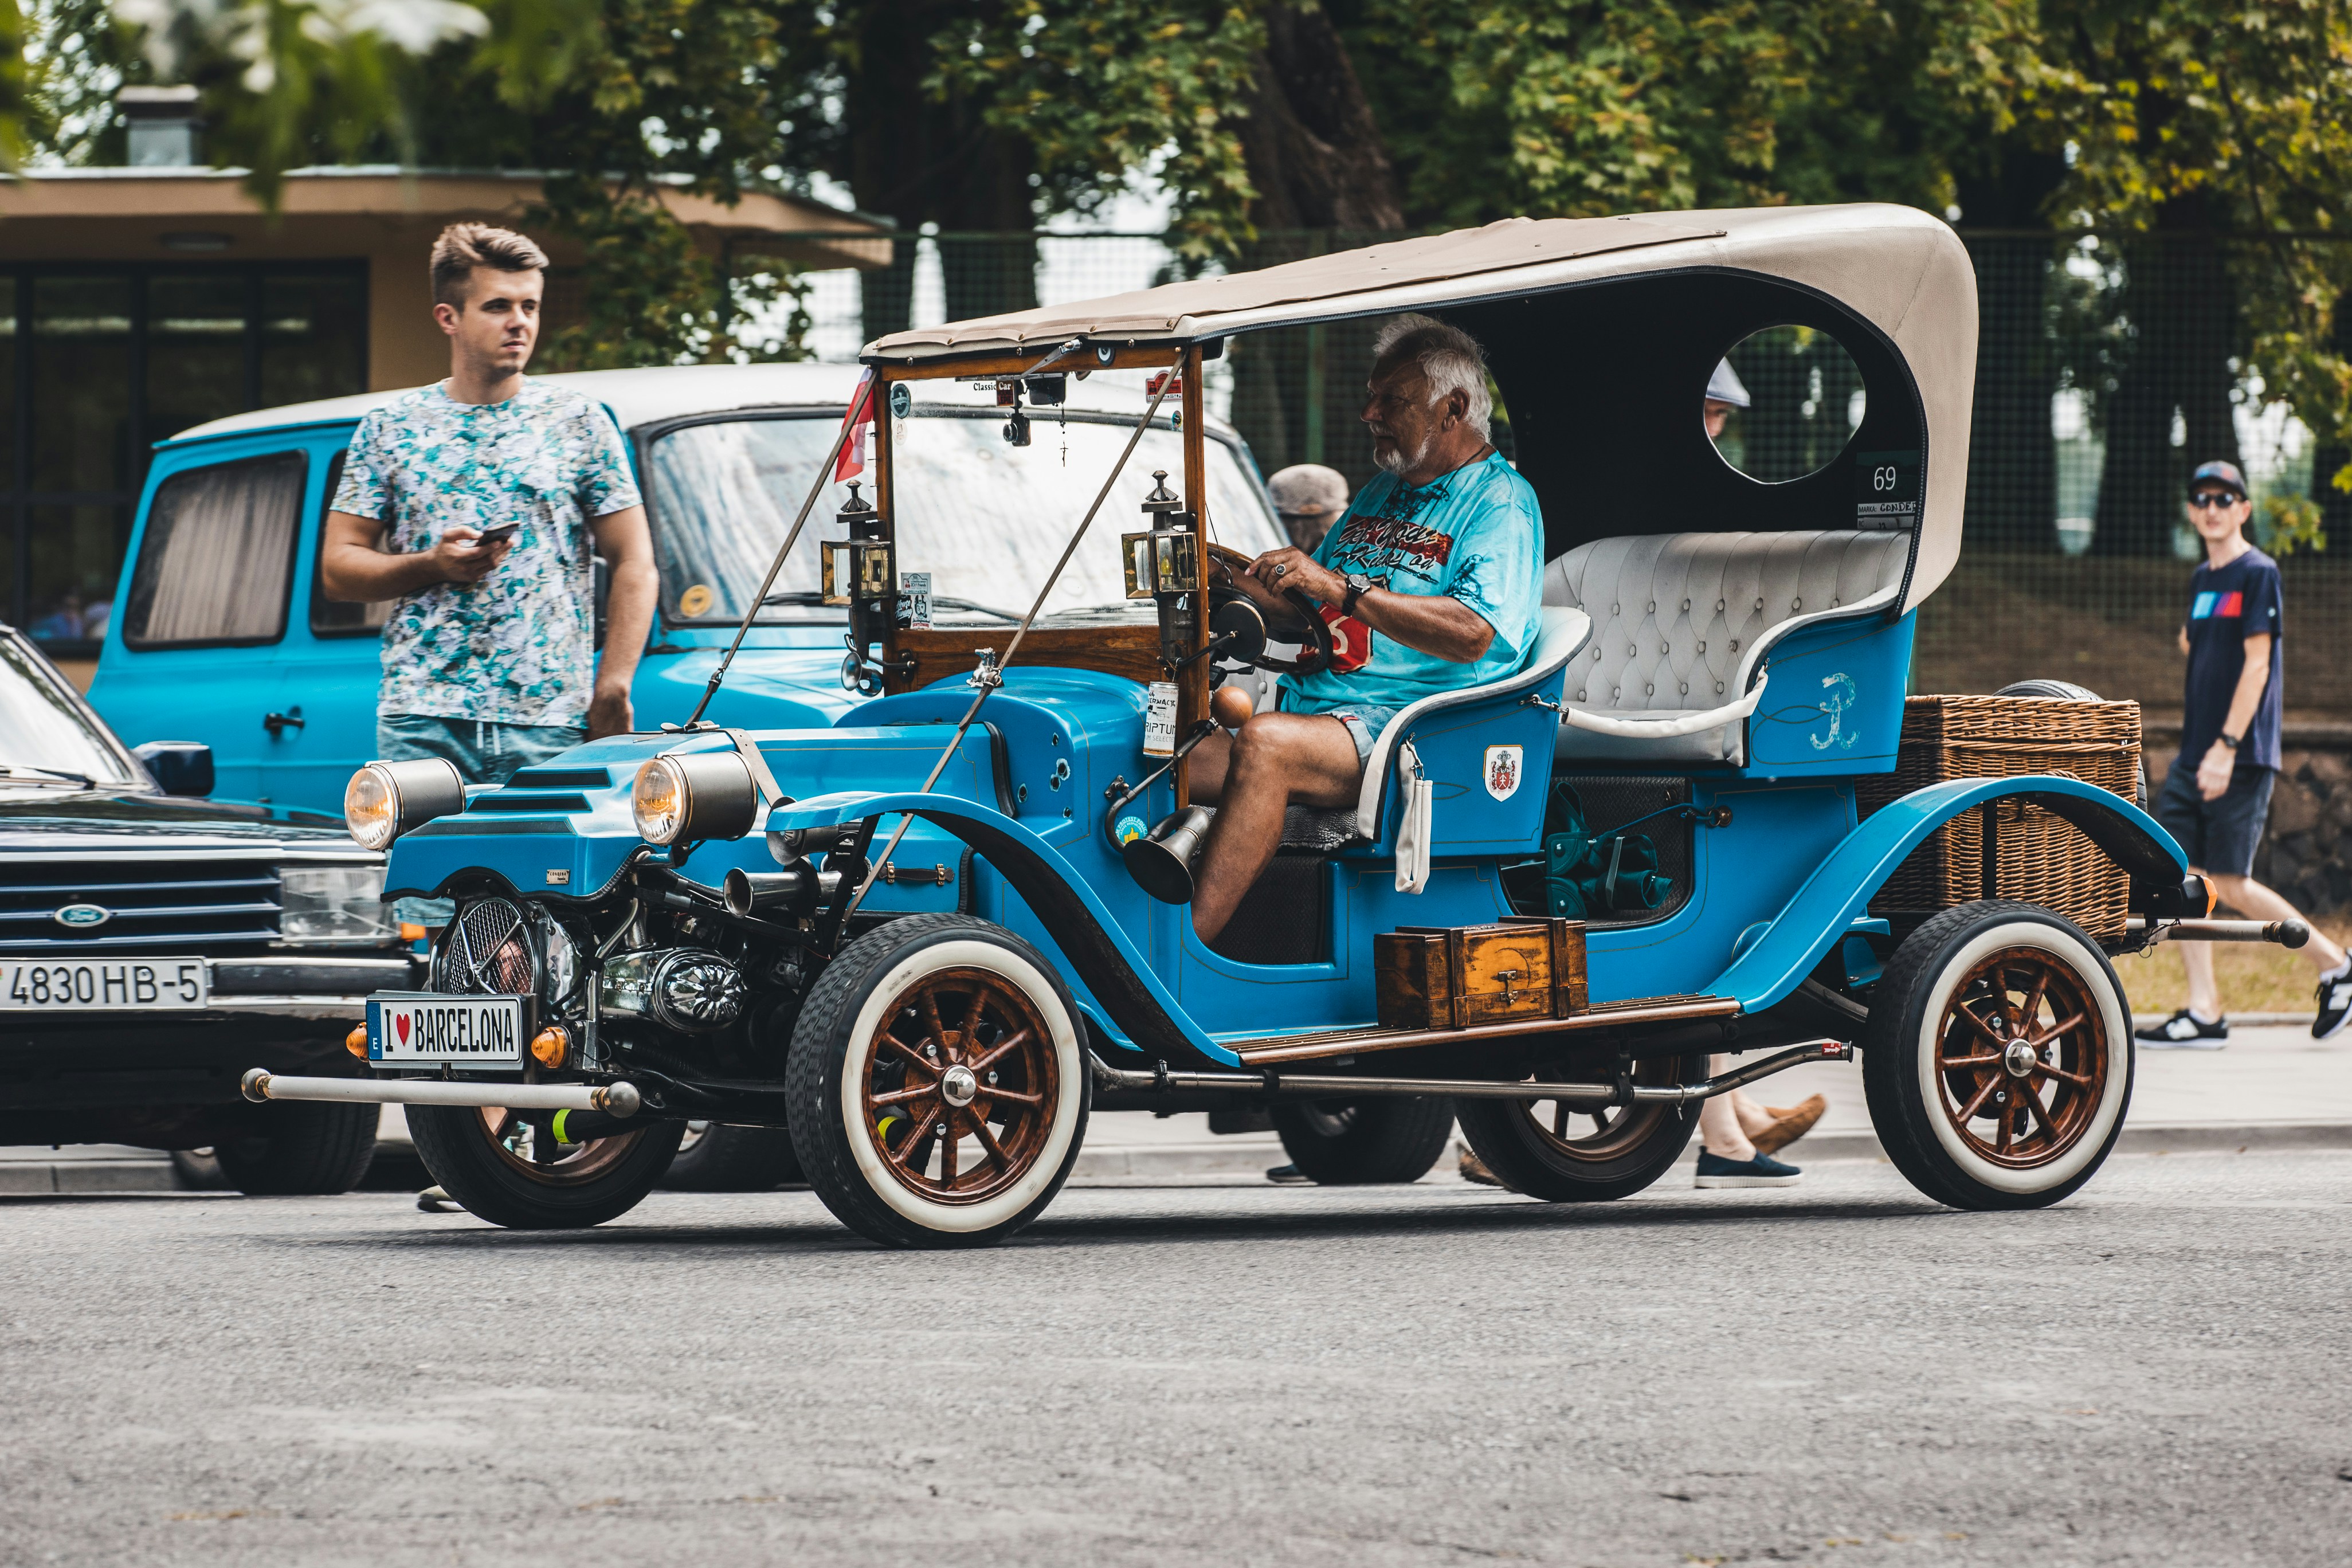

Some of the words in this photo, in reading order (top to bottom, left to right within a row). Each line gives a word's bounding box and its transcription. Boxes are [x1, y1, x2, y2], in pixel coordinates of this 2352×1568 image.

[974, 382, 997, 390] Classic
[998, 382, 1011, 390] Car
[1874, 467, 1896, 491] 69
[11, 966, 94, 1003] 4830
[102, 965, 198, 1003] HB-5
[385, 1009, 394, 1052] I
[414, 1008, 514, 1052] BARCELONA
[373, 1038, 378, 1050] E
